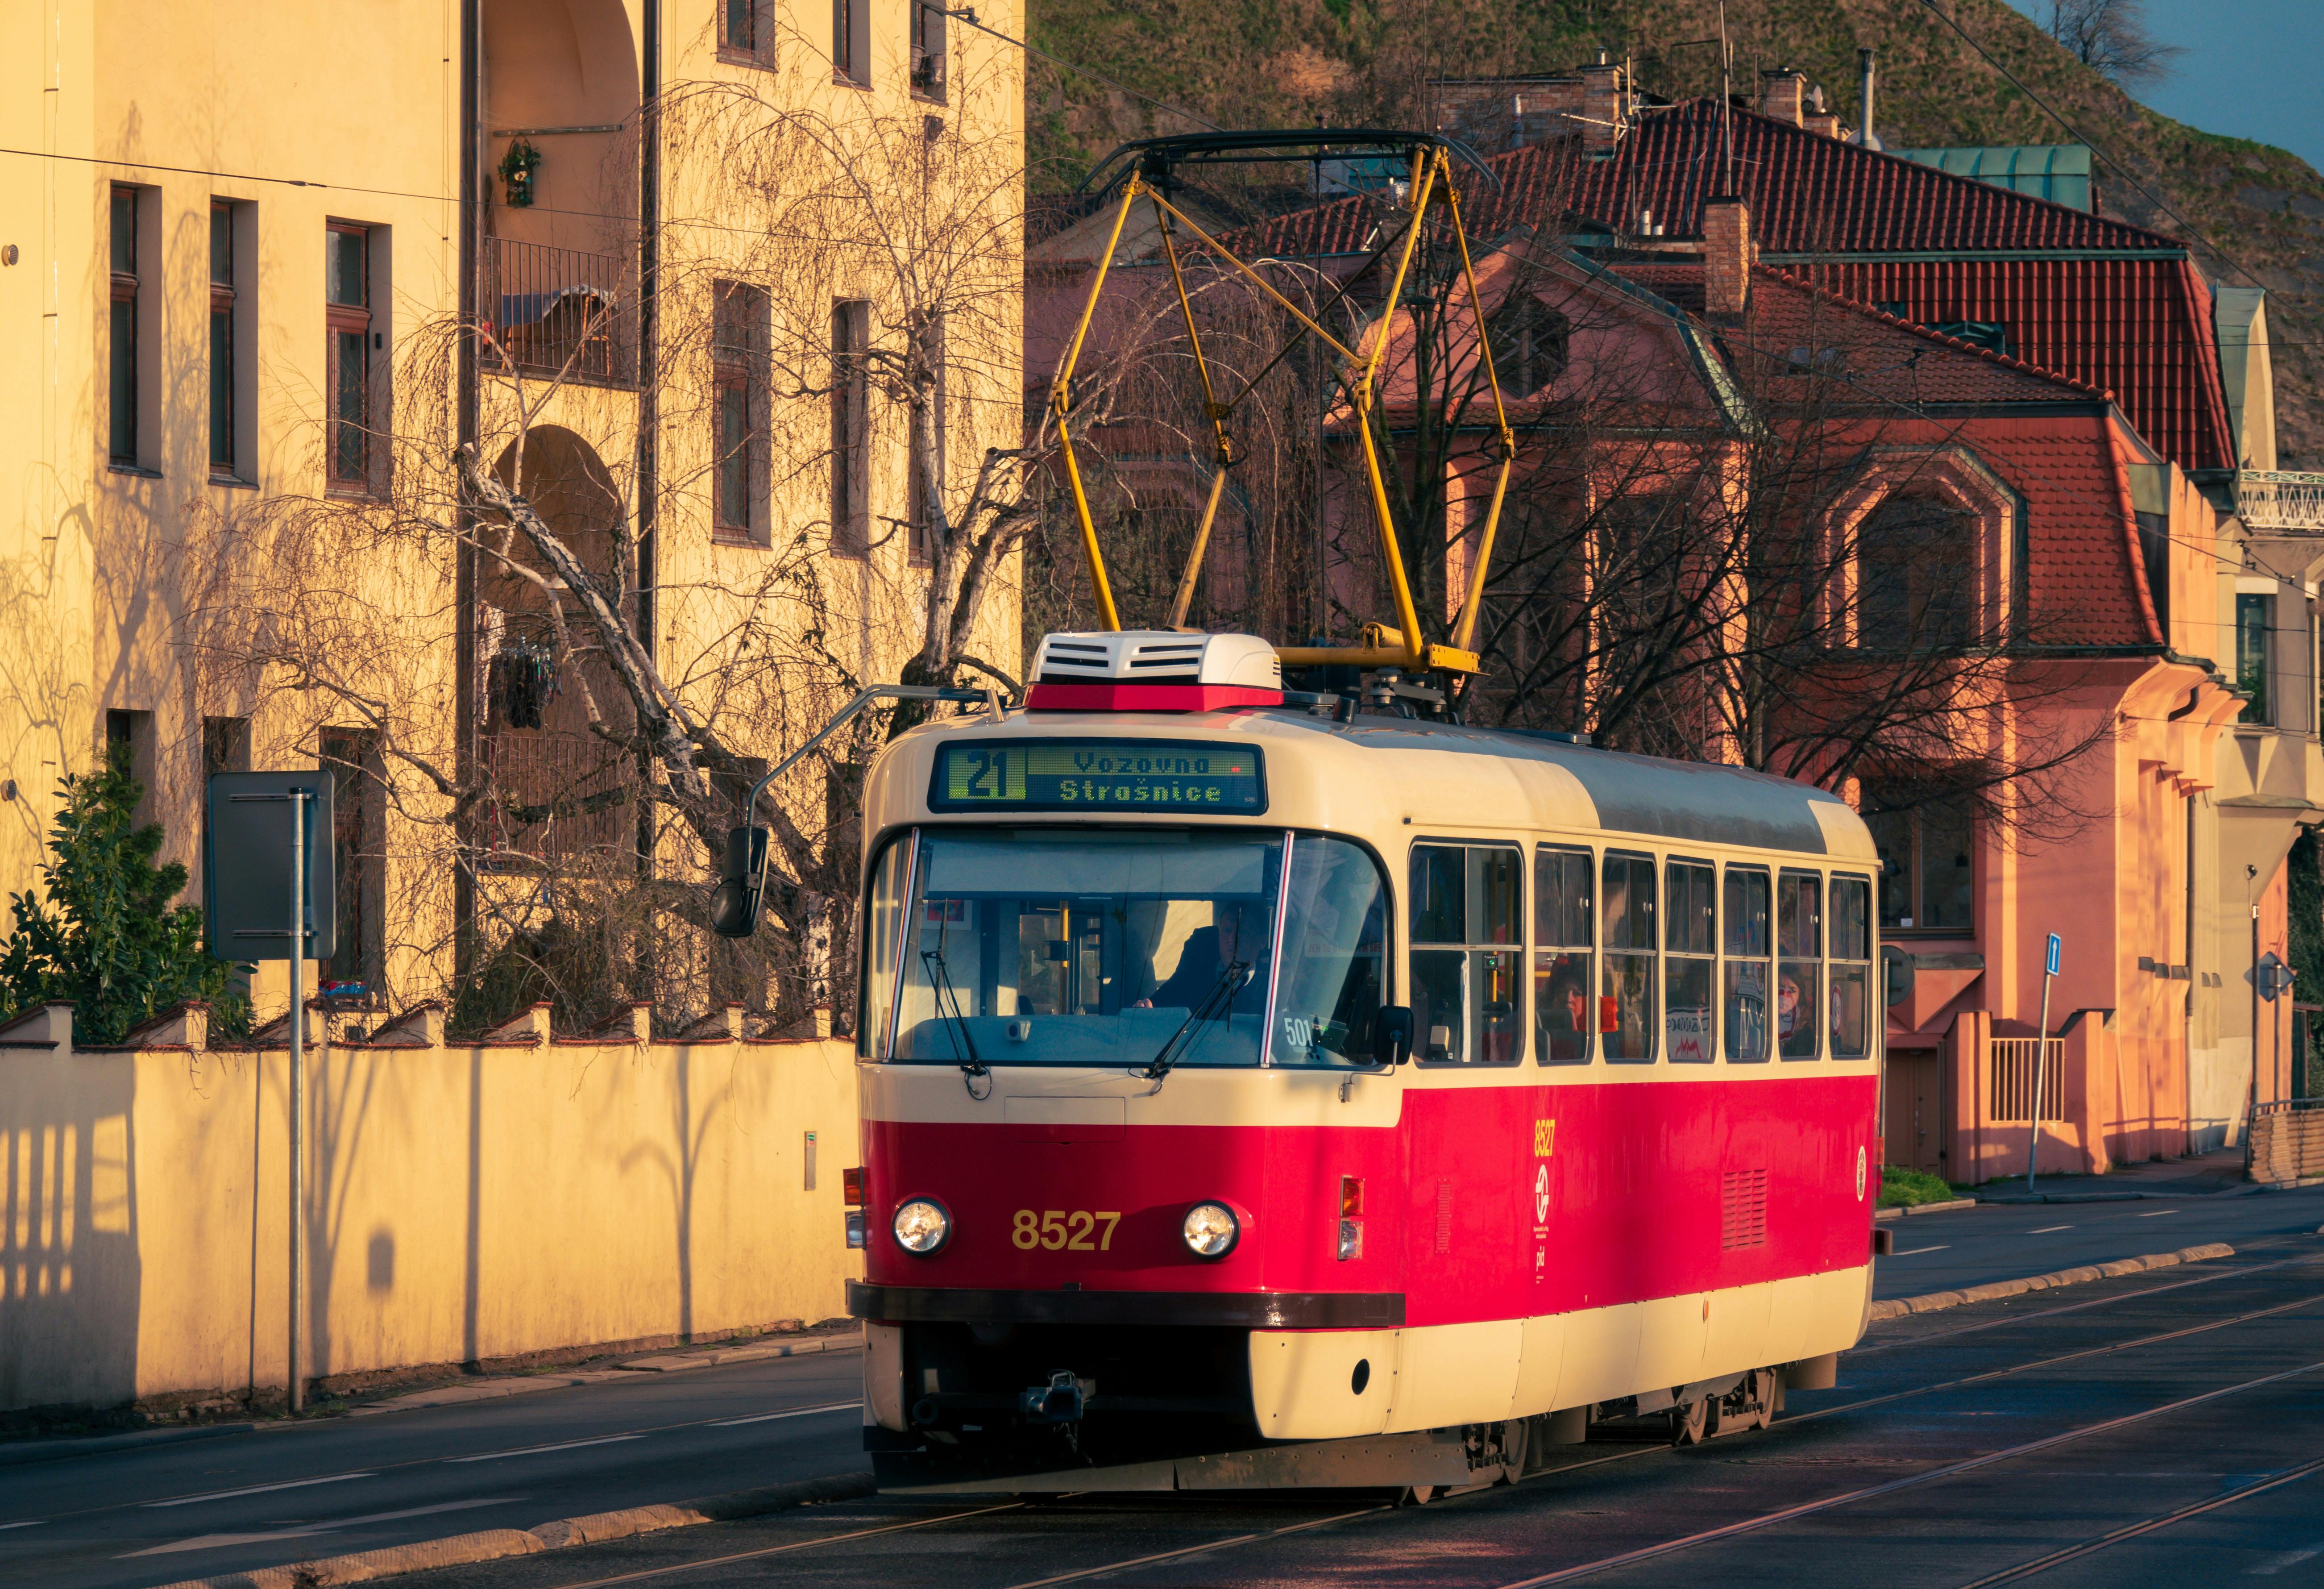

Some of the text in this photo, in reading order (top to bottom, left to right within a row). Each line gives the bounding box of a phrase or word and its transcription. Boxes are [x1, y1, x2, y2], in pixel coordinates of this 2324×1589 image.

[967, 751, 1007, 797] 21
[1074, 752, 1209, 774] Vozovna
[1060, 778, 1221, 802] Strašnice
[1284, 1017, 1313, 1047] 501
[1534, 1119, 1556, 1157] 8527
[1012, 1209, 1121, 1251] 8527
[1536, 1245, 1545, 1272] pid
